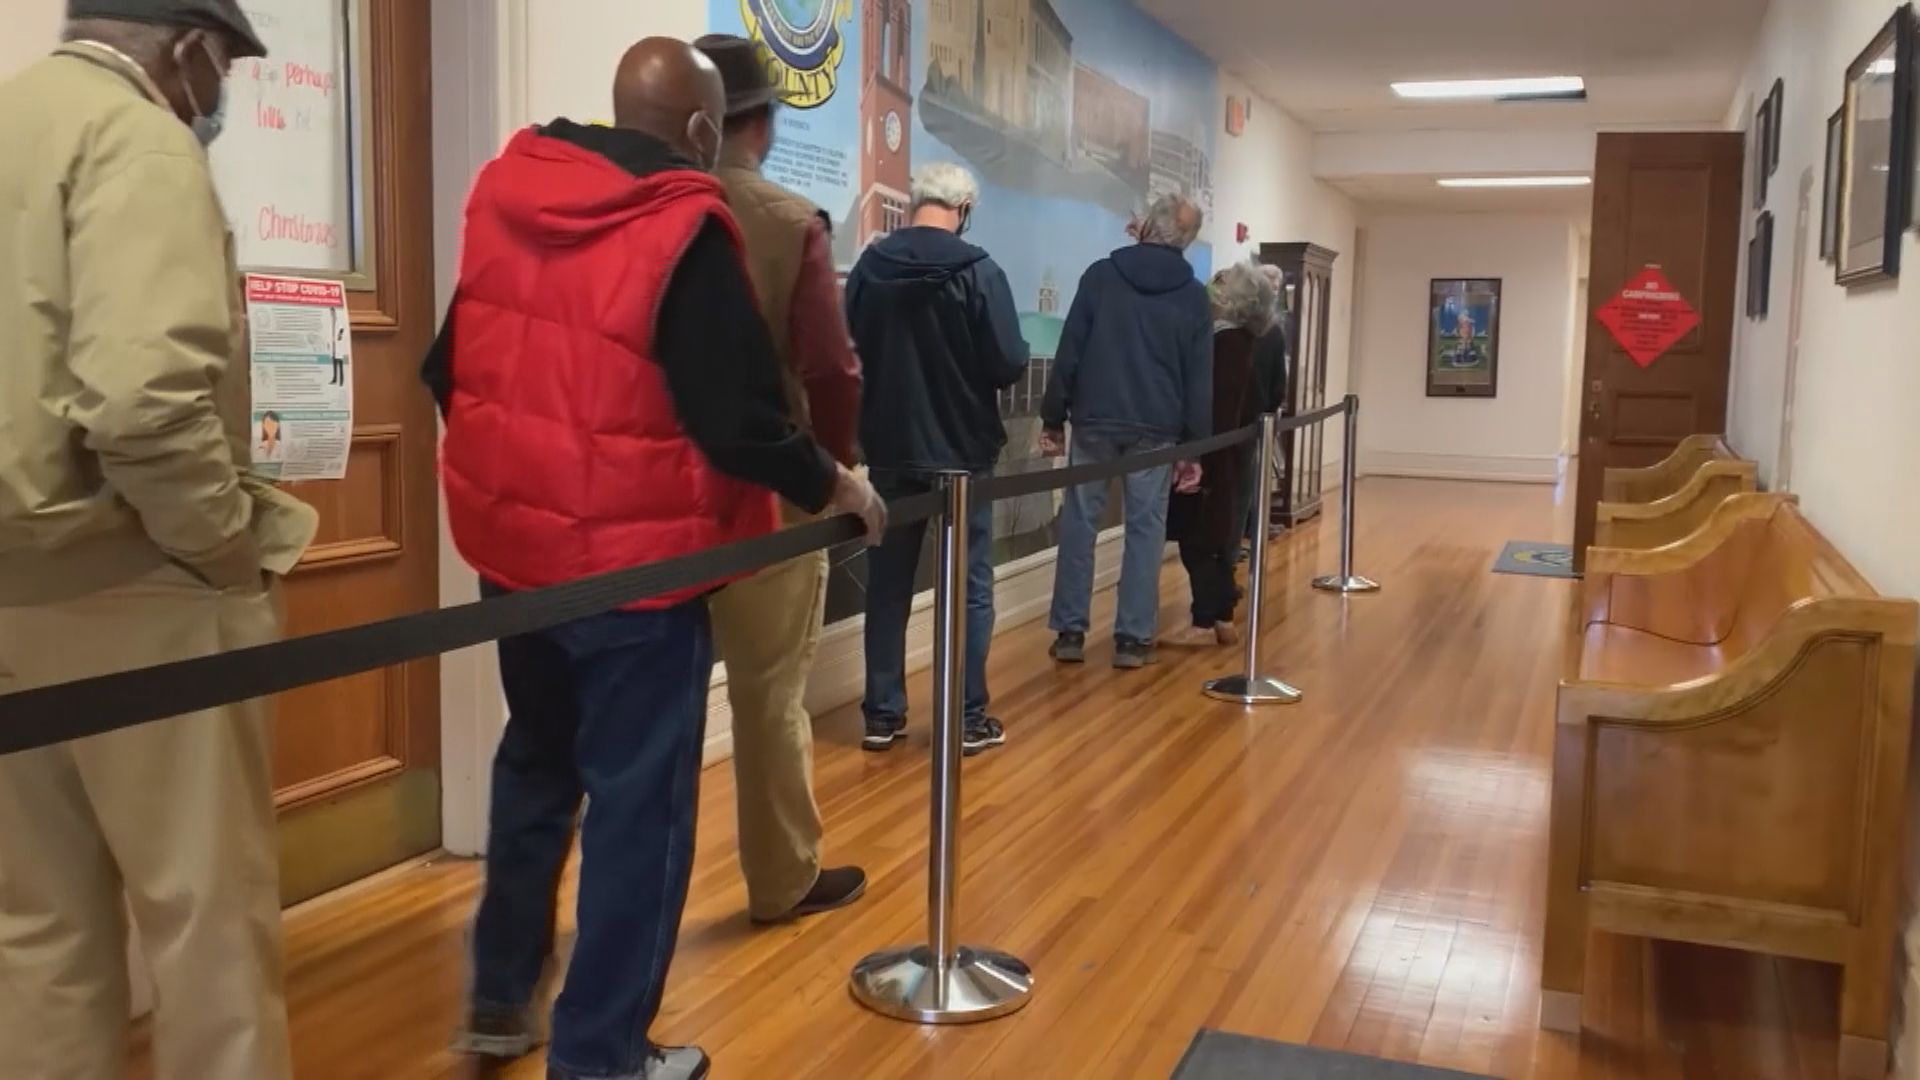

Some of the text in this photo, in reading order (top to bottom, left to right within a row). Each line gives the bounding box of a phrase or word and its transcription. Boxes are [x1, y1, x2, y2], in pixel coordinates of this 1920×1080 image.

[258, 204, 337, 248] Christmas
[249, 280, 340, 297] HELP STOP COVID-19
